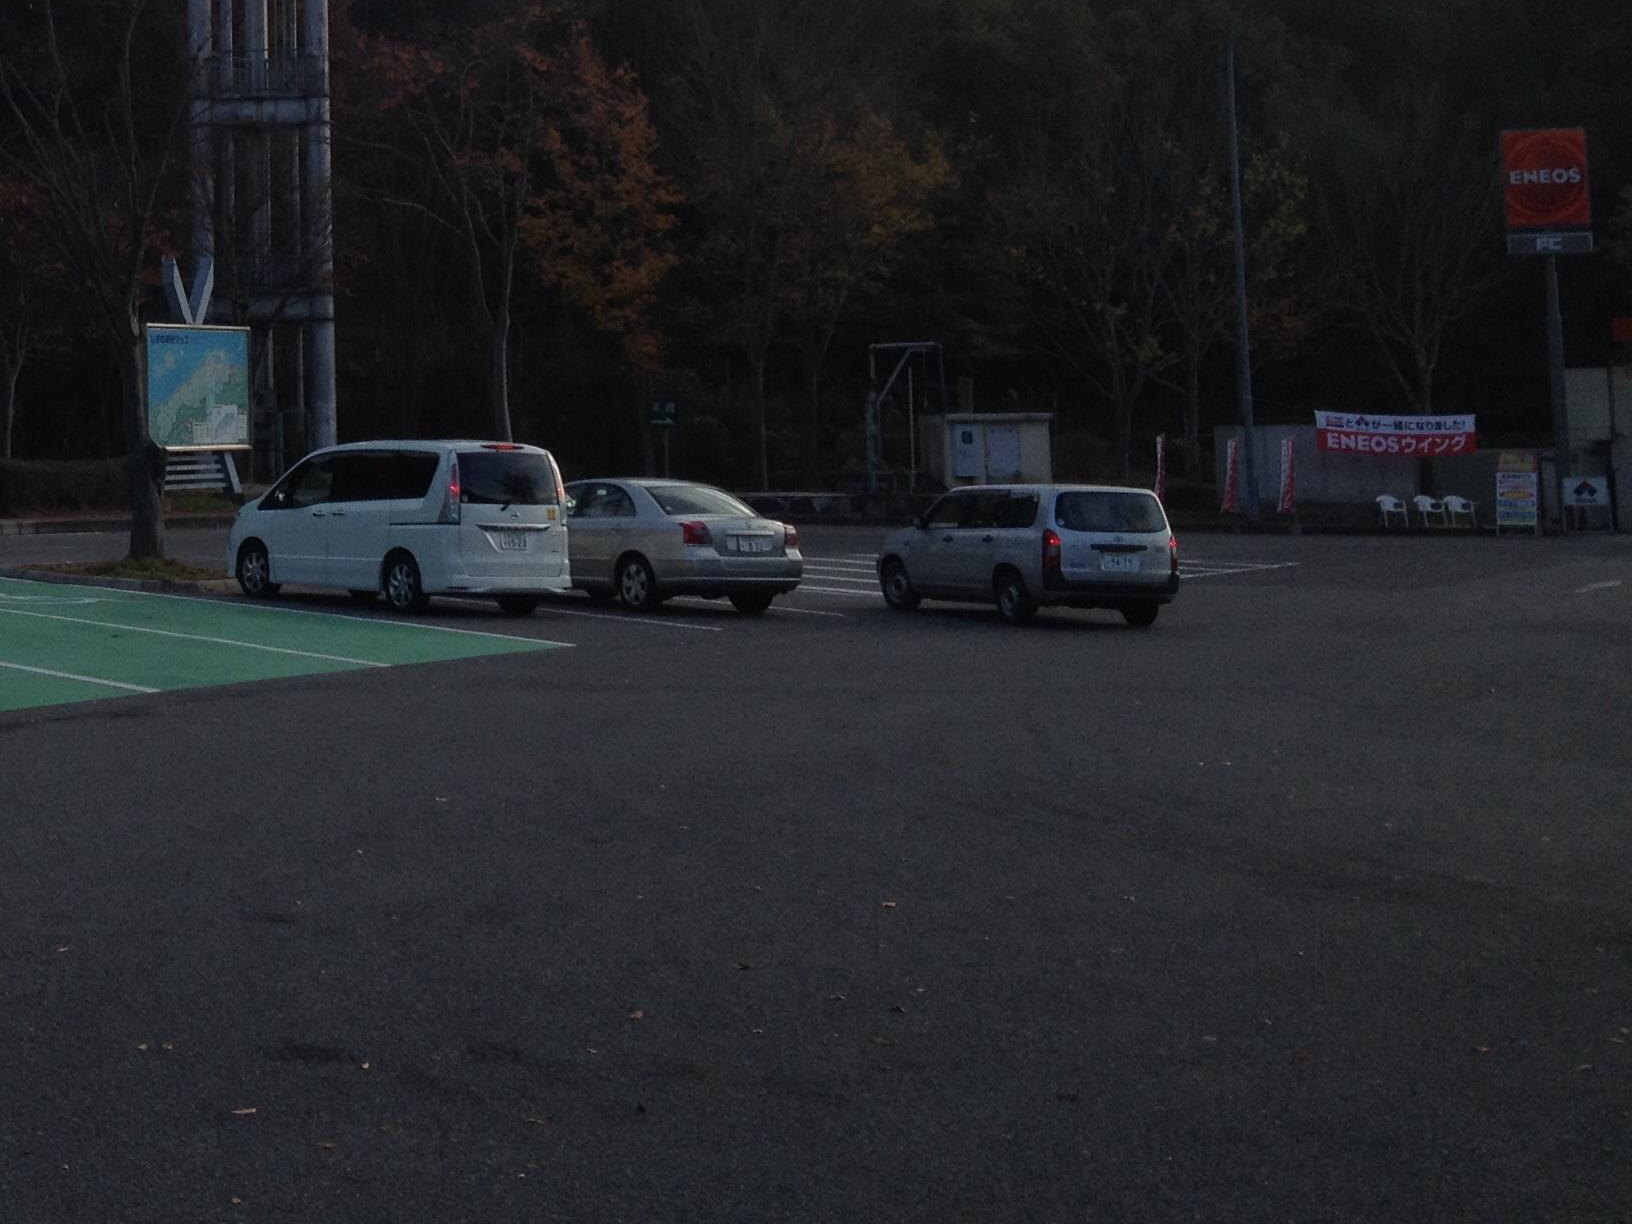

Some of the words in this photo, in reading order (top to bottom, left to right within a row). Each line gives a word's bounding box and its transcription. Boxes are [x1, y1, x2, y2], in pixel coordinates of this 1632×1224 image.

[1509, 168, 1581, 184] ENEOS
[1536, 237, 1562, 250] FC
[1327, 432, 1467, 454] ENEOSウイング
